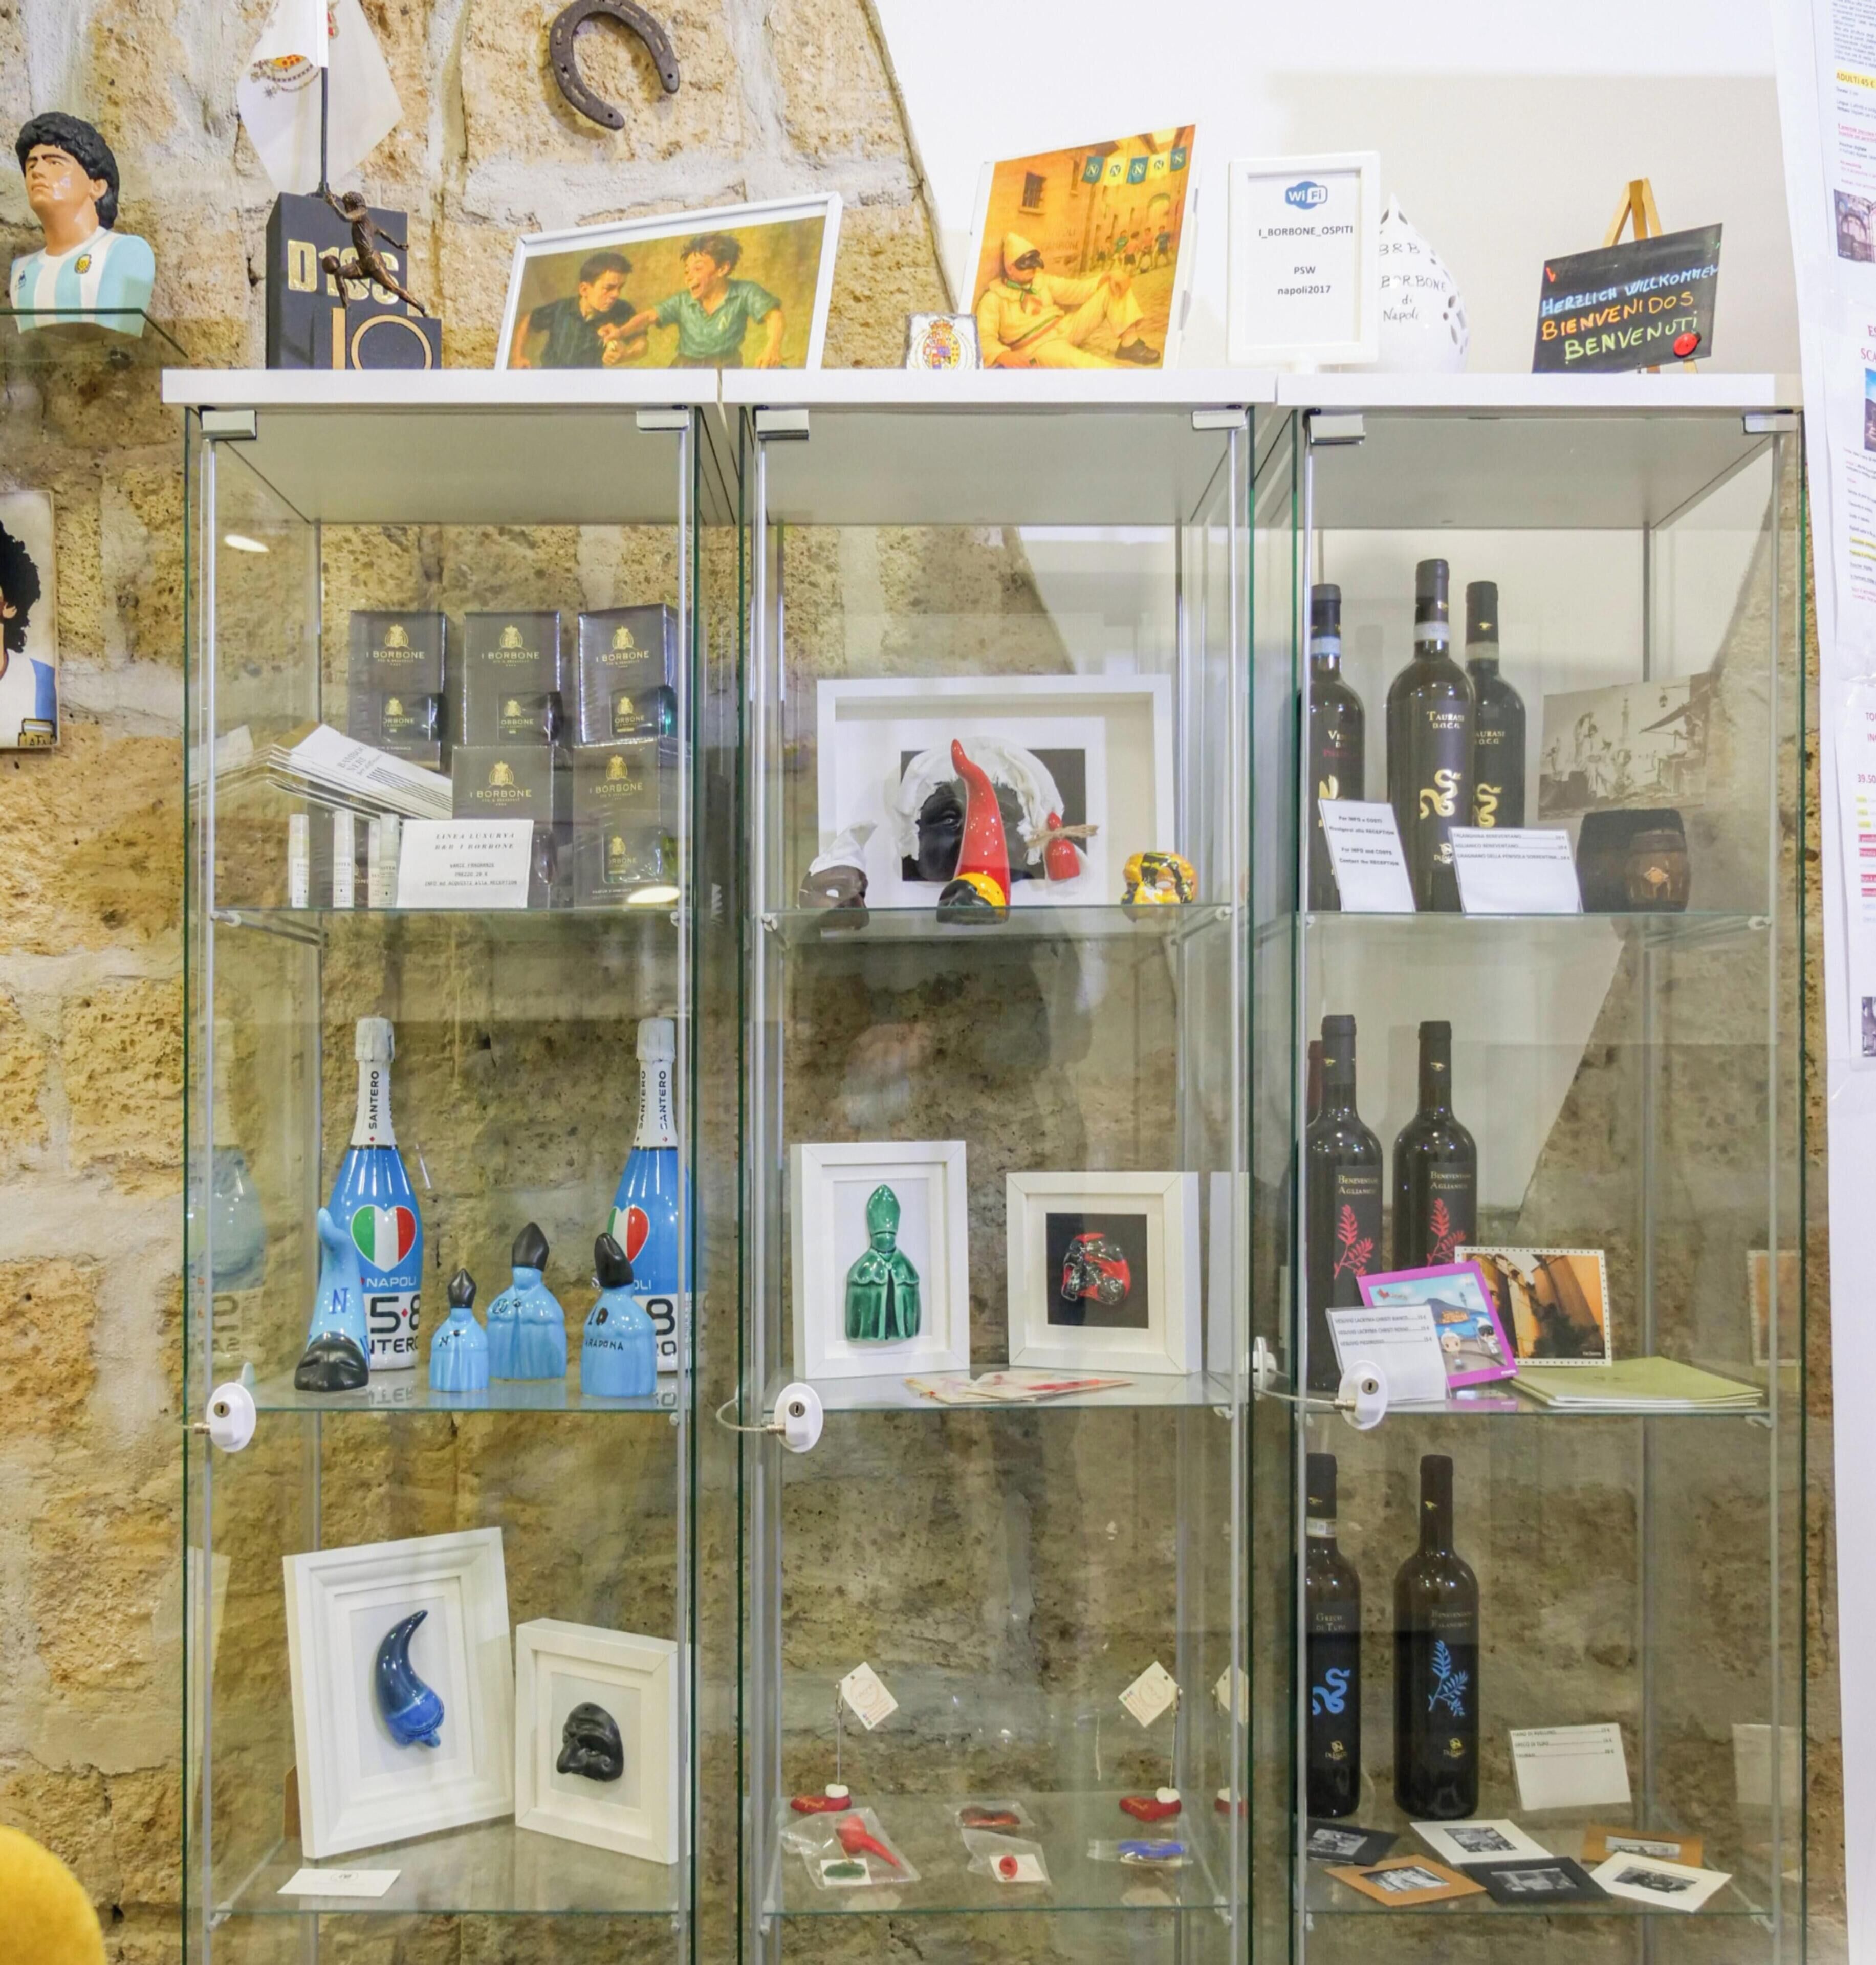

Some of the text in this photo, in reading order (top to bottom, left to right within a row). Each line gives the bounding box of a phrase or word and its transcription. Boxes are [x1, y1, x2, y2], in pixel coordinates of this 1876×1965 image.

[1259, 226, 1353, 239] I_BORBONE_OSPITI
[1277, 285, 1331, 296] napoli2017
[1540, 287, 1617, 317] HERZLICH
[1383, 307, 1419, 323] Napoli
[1541, 291, 1694, 341] BIENVENIDOS
[373, 651, 425, 659] BORBONE
[602, 650, 649, 662] BORBONE
[477, 789, 532, 798] BORBONE
[595, 782, 643, 794] BORBONE
[368, 1071, 379, 1129] SANTERO
[634, 1280, 652, 1290] OLI
[329, 1287, 348, 1314] N
[370, 1336, 418, 1355] NTERO
